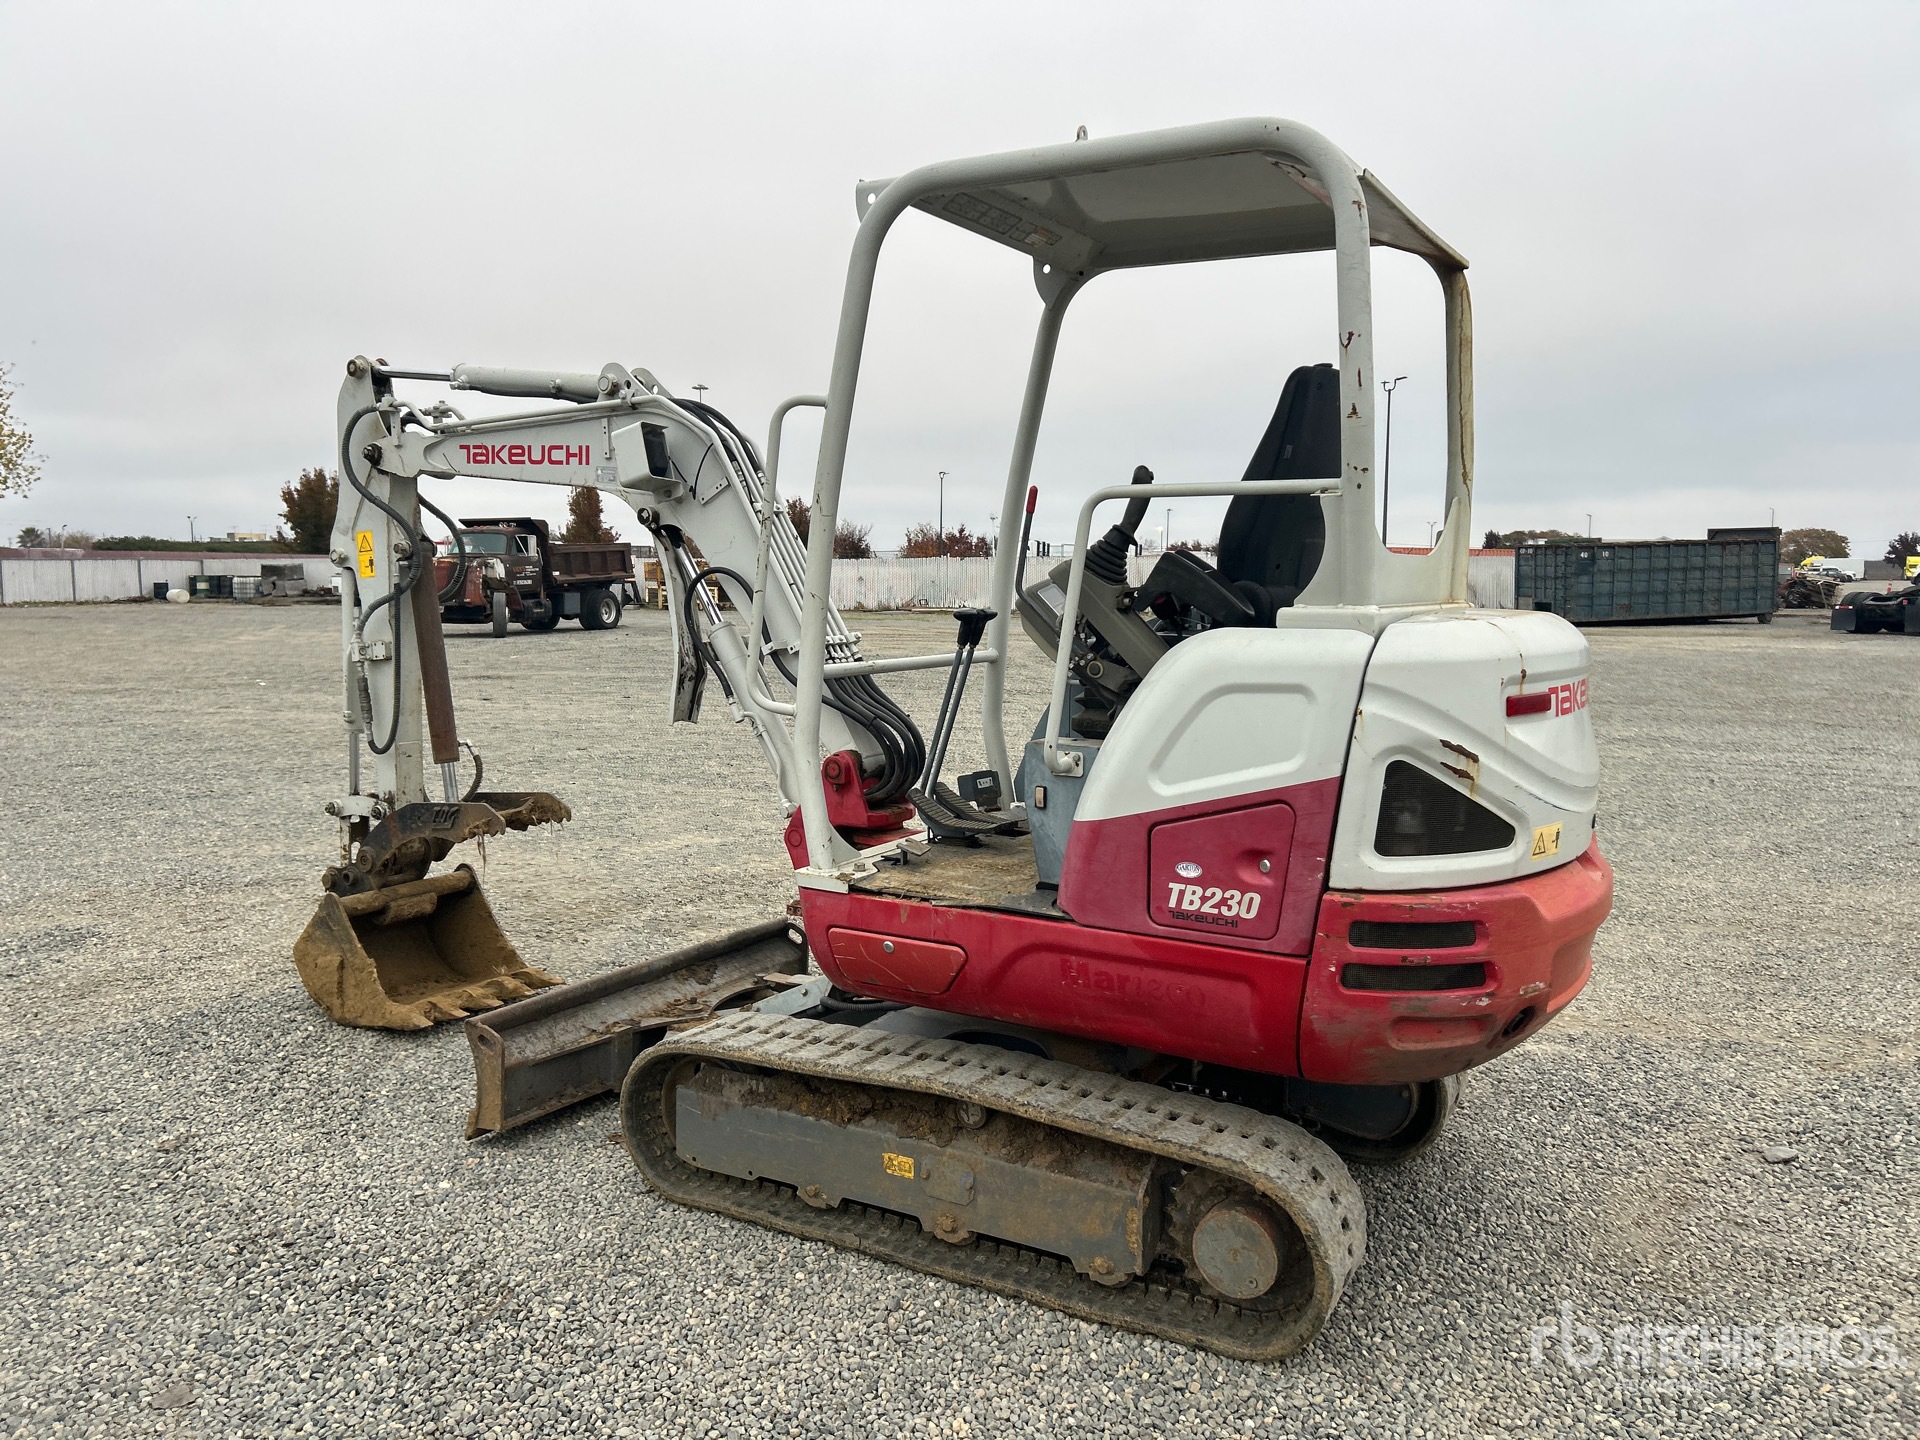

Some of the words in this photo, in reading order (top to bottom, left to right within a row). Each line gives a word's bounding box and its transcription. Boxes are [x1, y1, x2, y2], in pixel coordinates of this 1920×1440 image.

[459, 444, 590, 465] TAKEUCHI
[1168, 882, 1261, 919] TB230
[1168, 910, 1238, 928] TAKEUCHI
